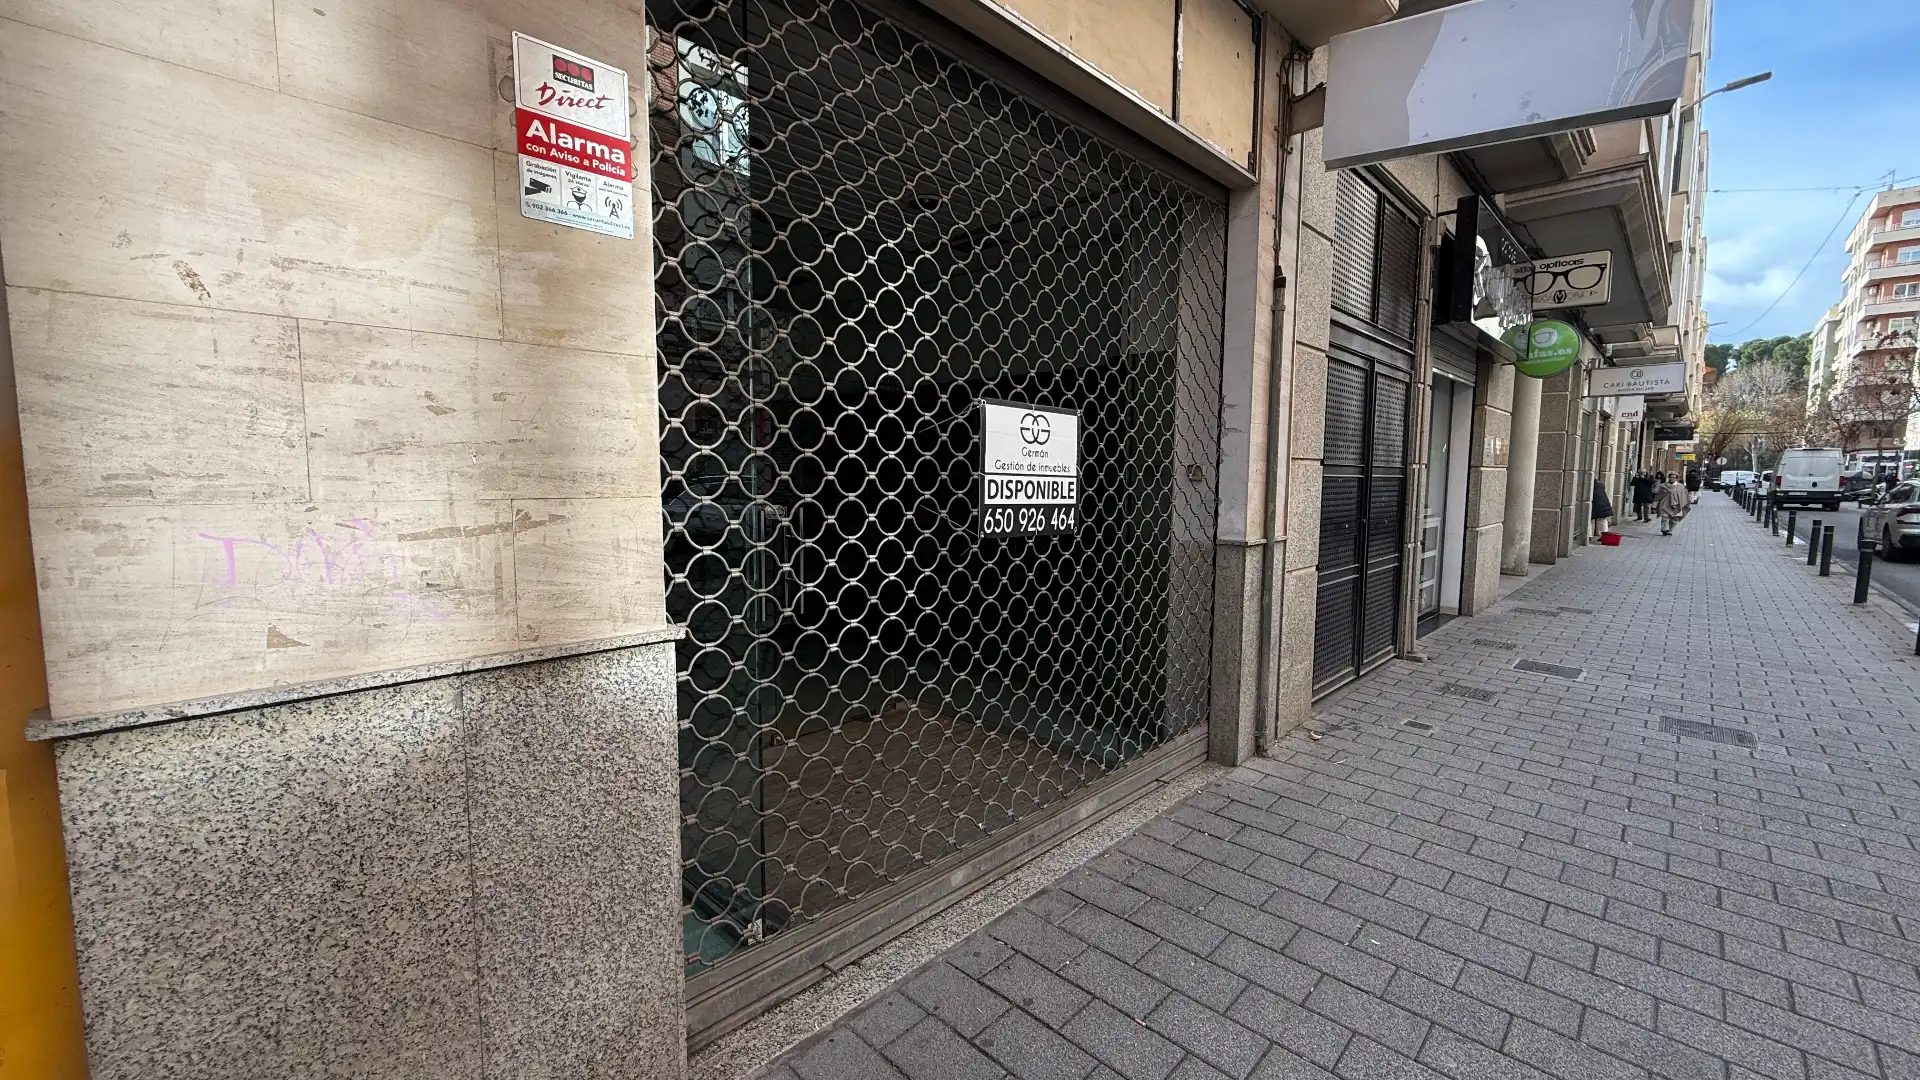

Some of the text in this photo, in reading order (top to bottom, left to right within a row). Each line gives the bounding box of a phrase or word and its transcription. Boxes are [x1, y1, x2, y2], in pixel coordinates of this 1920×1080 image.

[554, 71, 594, 91] SECURITAS
[535, 81, 615, 110] Direct
[525, 119, 626, 165] Alarma
[525, 142, 547, 156] con
[550, 147, 580, 164] Aviso
[592, 159, 626, 177] Policía
[526, 160, 557, 173] Grabación
[565, 170, 592, 182] Vigilante
[603, 181, 624, 191] Alarma
[1528, 347, 1573, 359] afas.es
[1627, 379, 1671, 387] BAUTISTA
[1021, 446, 1049, 459] Germán
[994, 459, 1025, 472] Gestión
[1026, 462, 1036, 471] de
[987, 478, 1075, 500] DISPONIBLE
[983, 506, 1075, 534] 650 926 464
